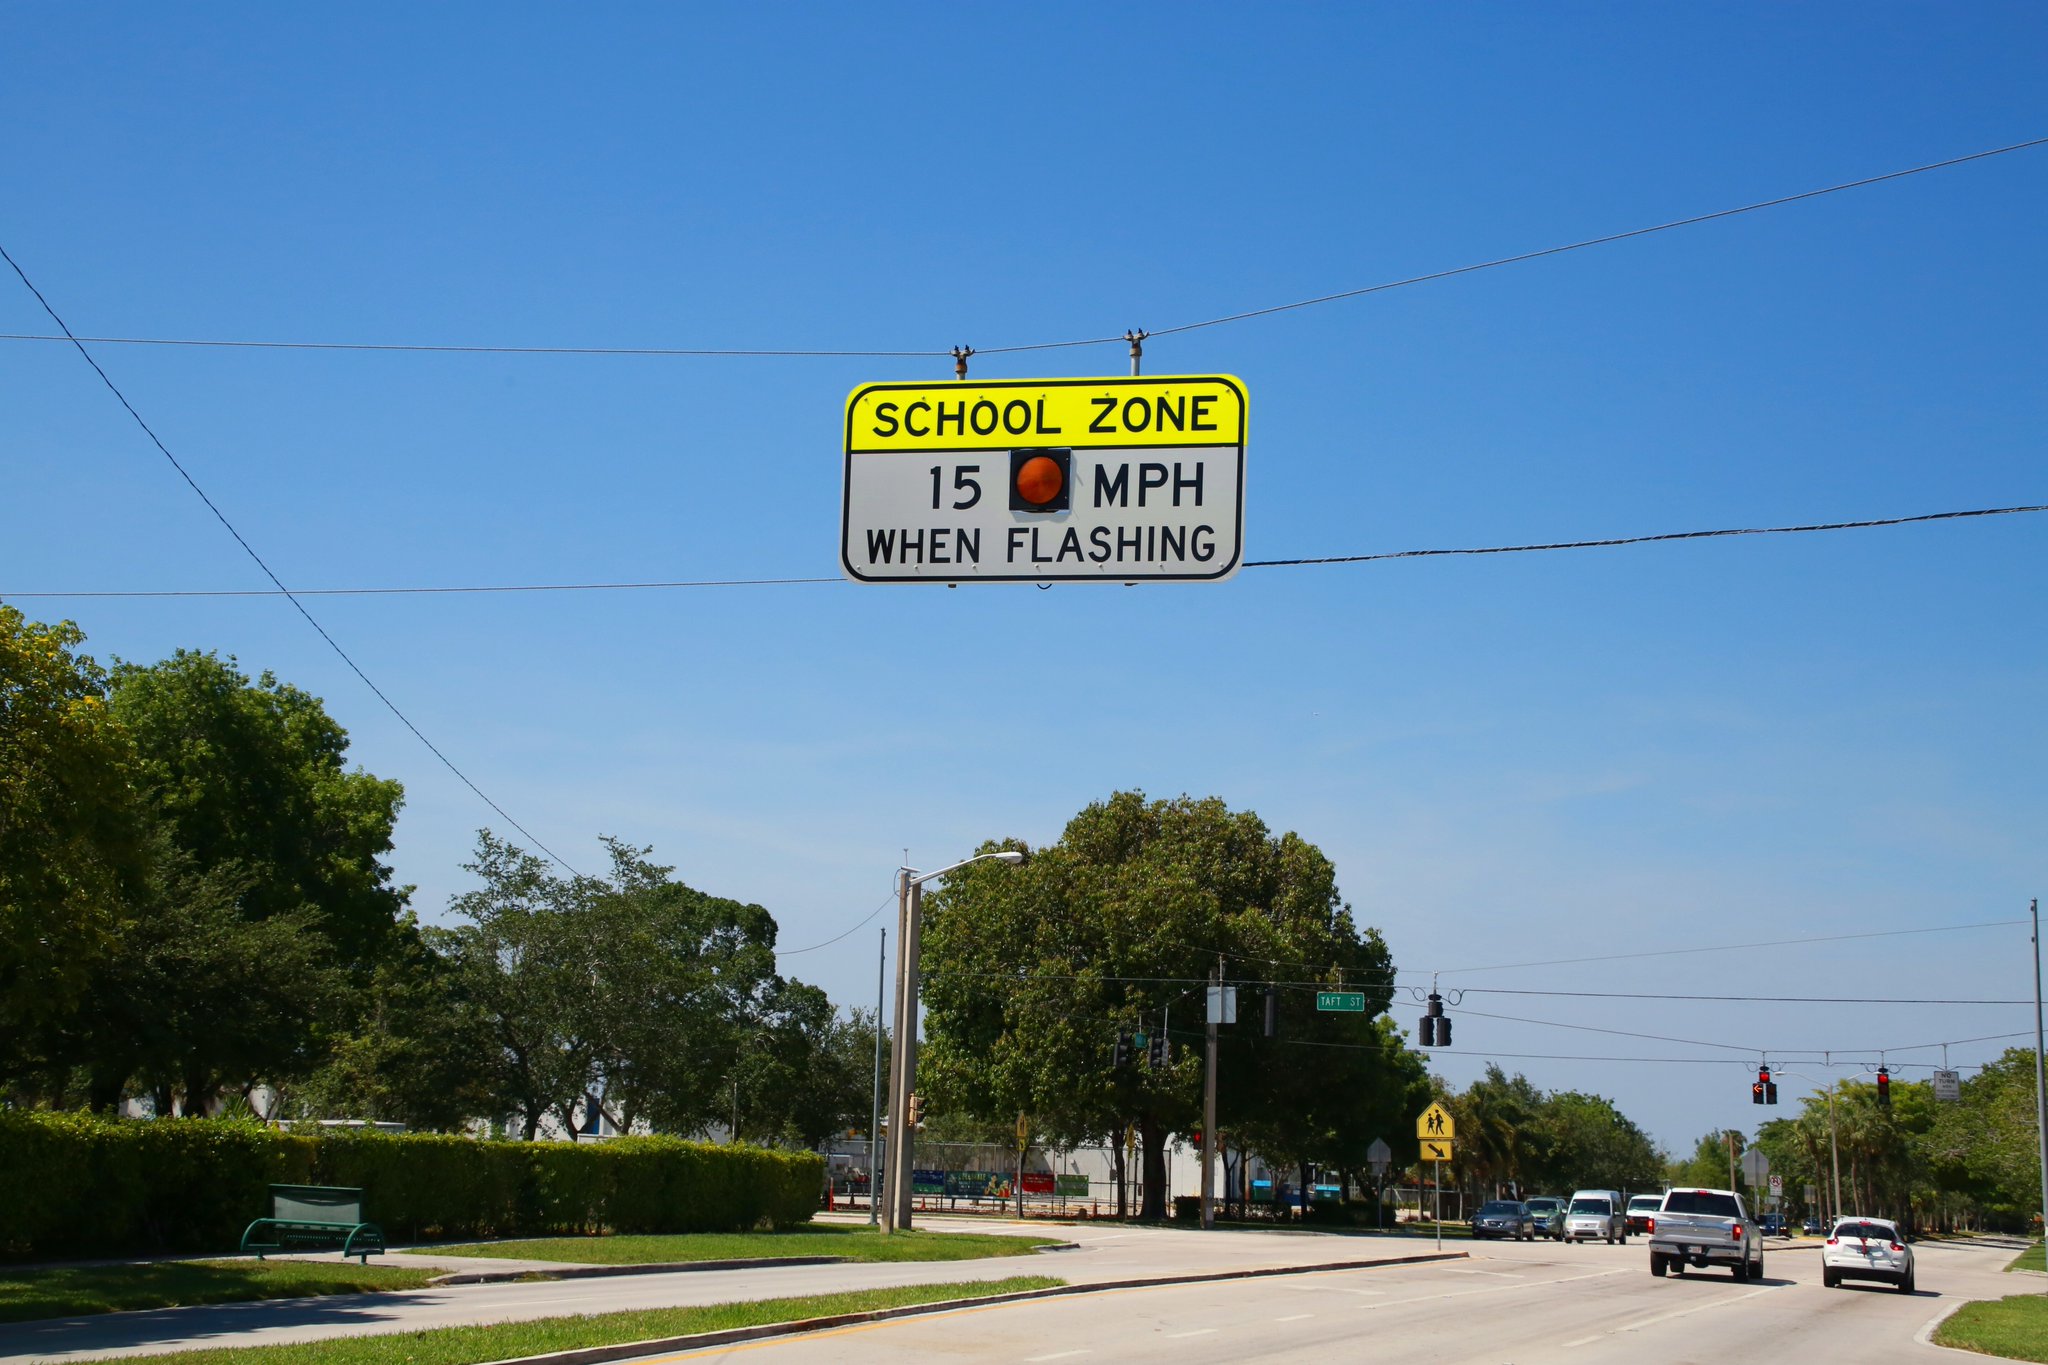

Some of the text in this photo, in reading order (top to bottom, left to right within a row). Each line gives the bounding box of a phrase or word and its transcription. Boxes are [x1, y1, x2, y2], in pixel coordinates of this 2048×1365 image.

[873, 395, 1218, 437] SCHOOL ZONE
[930, 462, 1204, 510] 15 MPH
[867, 524, 1215, 564] WHEN FLASHING
[1321, 996, 1360, 1006] TAFT ST
